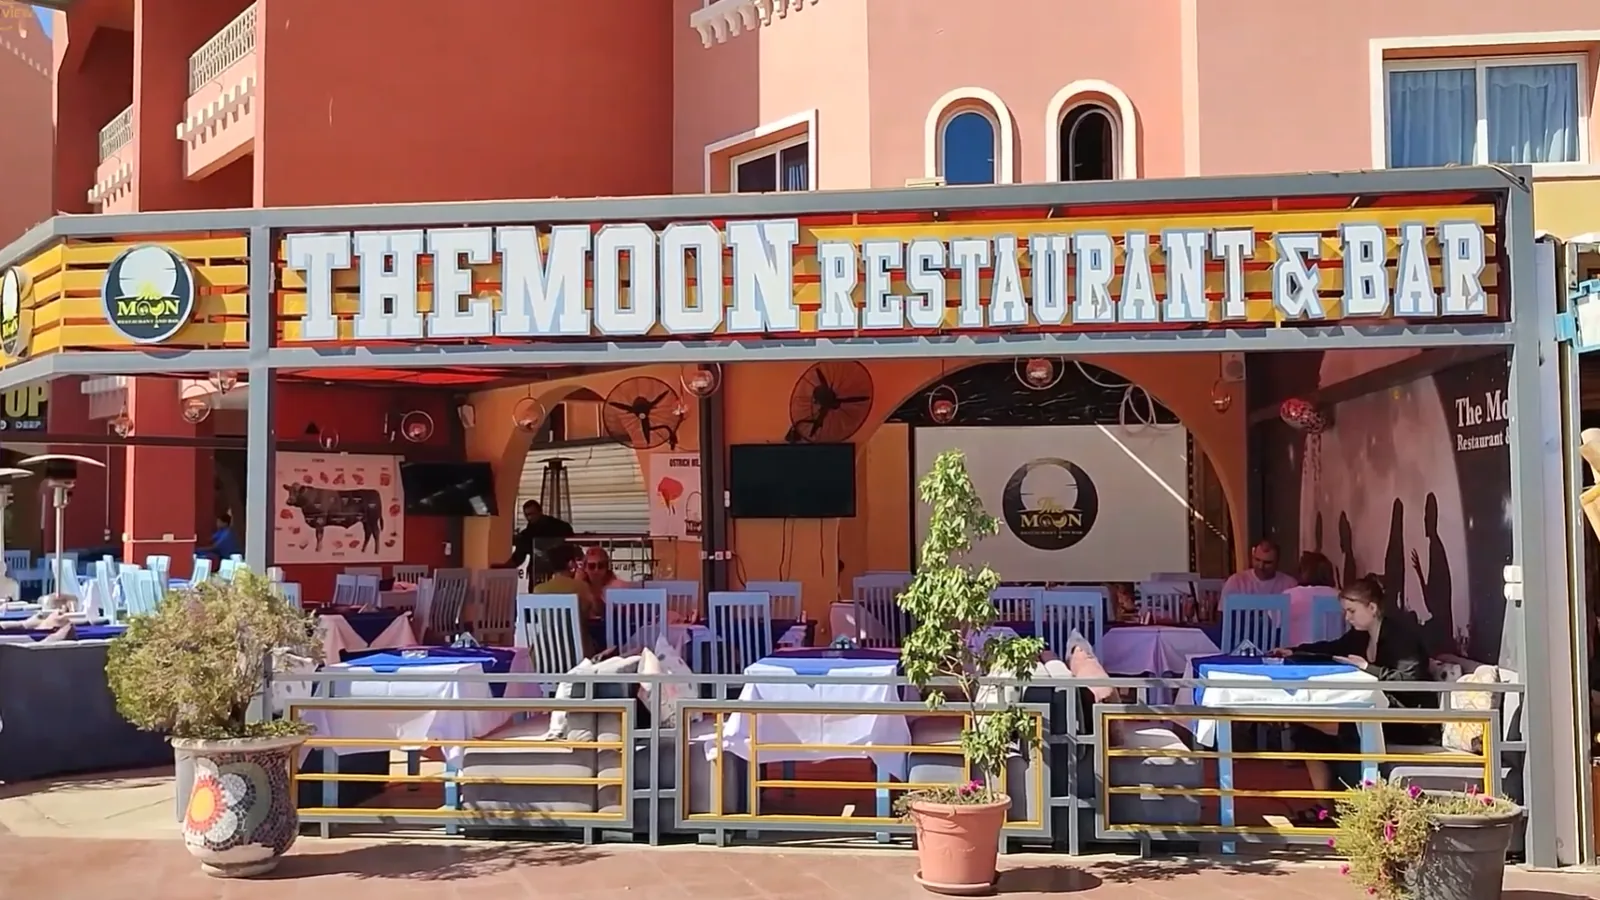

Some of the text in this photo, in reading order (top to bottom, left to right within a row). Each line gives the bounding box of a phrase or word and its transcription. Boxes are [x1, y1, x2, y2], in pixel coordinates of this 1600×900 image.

[818, 227, 1254, 330] RESTAURANT
[1271, 233, 1326, 320] &
[1339, 221, 1487, 317] BAR
[117, 300, 180, 316] MOON
[1455, 396, 1482, 427] The
[1457, 431, 1503, 451] Restaurant
[1020, 514, 1083, 528] MOON
